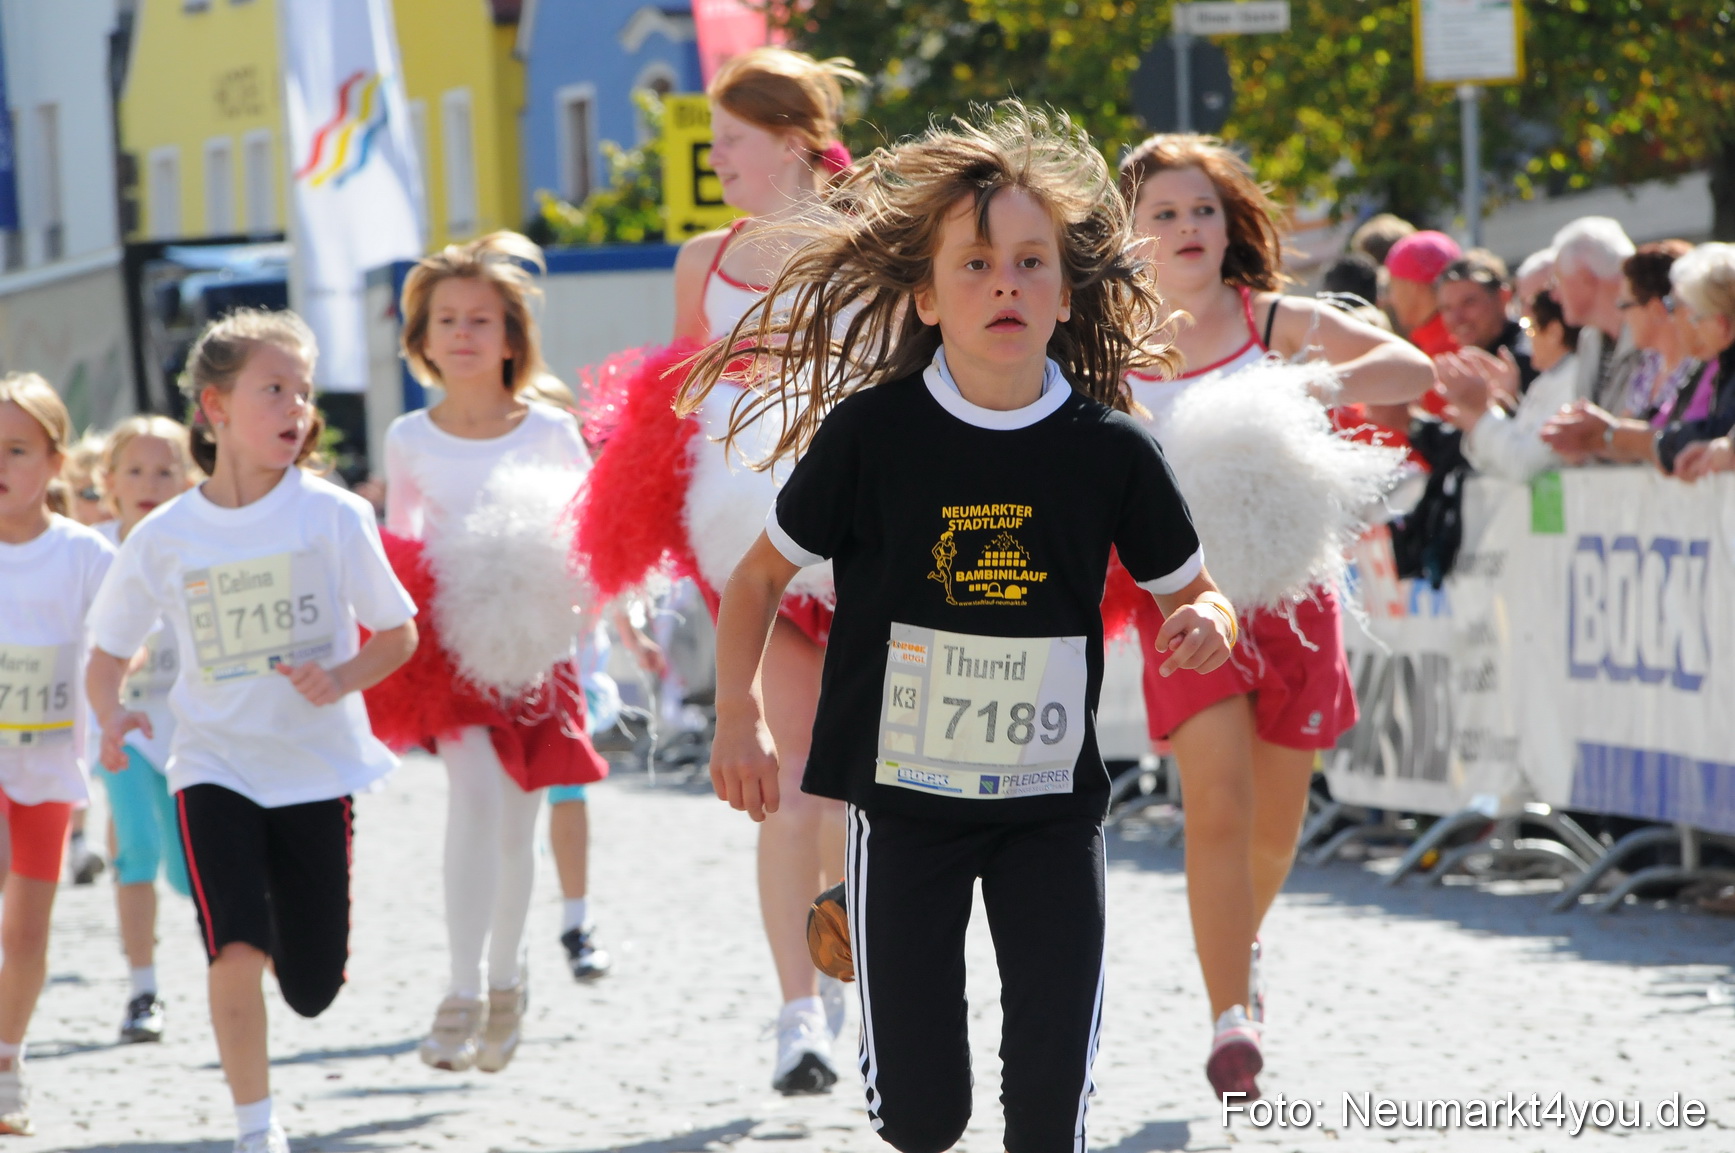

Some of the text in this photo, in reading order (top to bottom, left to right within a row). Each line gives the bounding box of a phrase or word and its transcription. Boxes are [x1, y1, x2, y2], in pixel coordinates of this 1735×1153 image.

[942, 504, 1032, 518] NEUMARKTER
[948, 517, 1023, 531] STADTLAUF
[218, 571, 274, 595] Celina
[956, 569, 1047, 582] BAMBINILAUF
[227, 594, 319, 639] 7185
[944, 647, 1027, 681] Thurid
[0, 683, 69, 711] 7115
[893, 685, 917, 710] K3
[942, 696, 1068, 745] 7189
[1002, 769, 1070, 787] PFLEIDERER
